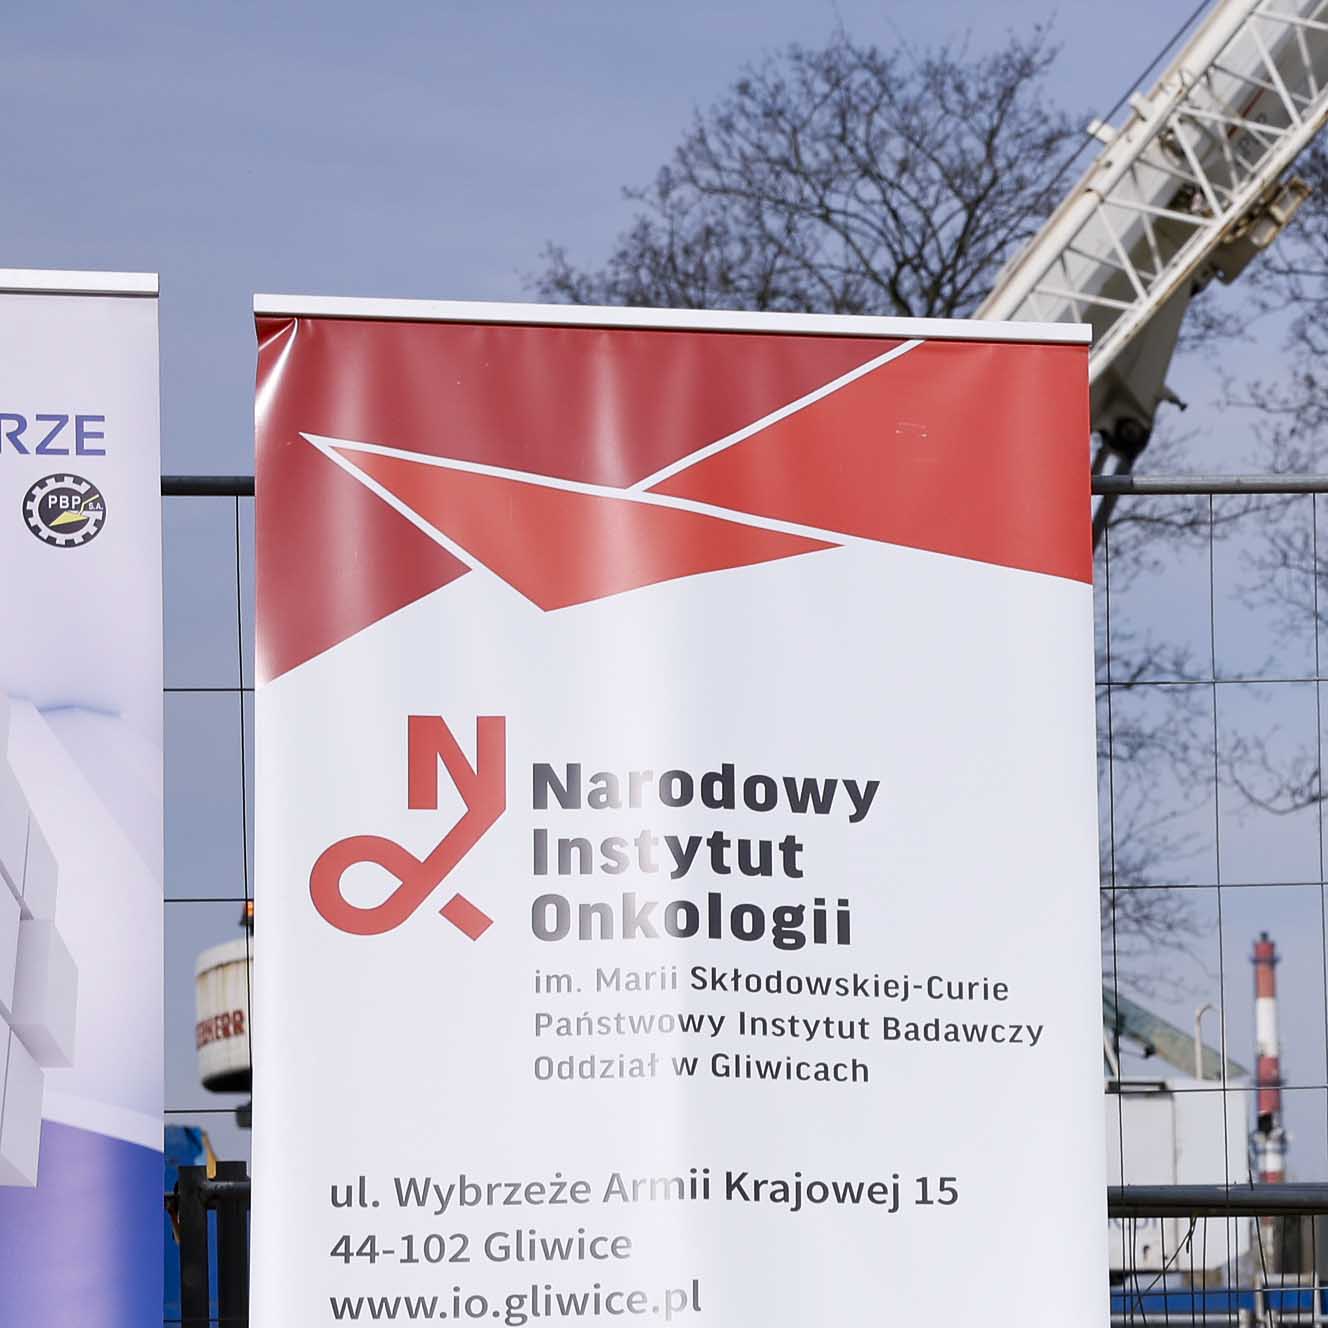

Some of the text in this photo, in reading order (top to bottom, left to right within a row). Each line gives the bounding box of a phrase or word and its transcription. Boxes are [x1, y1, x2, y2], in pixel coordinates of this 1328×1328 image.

[48, 495, 81, 509] PBP
[532, 762, 881, 823] Narodowy
[532, 827, 805, 879] Instytut
[531, 892, 852, 950] Onkologii
[534, 964, 1010, 1001] im. Marii Skłodowskiej-Curie
[535, 1007, 1044, 1047] Państwowy Instytut Badawczy
[534, 1052, 870, 1084] Oddział w Gliwicach
[330, 1169, 959, 1216] ul. Wybrzeże Armii Krajowej 15
[330, 1227, 633, 1265] 44-102 Gliwice
[329, 1279, 703, 1327] www.io.gliwice.pl
